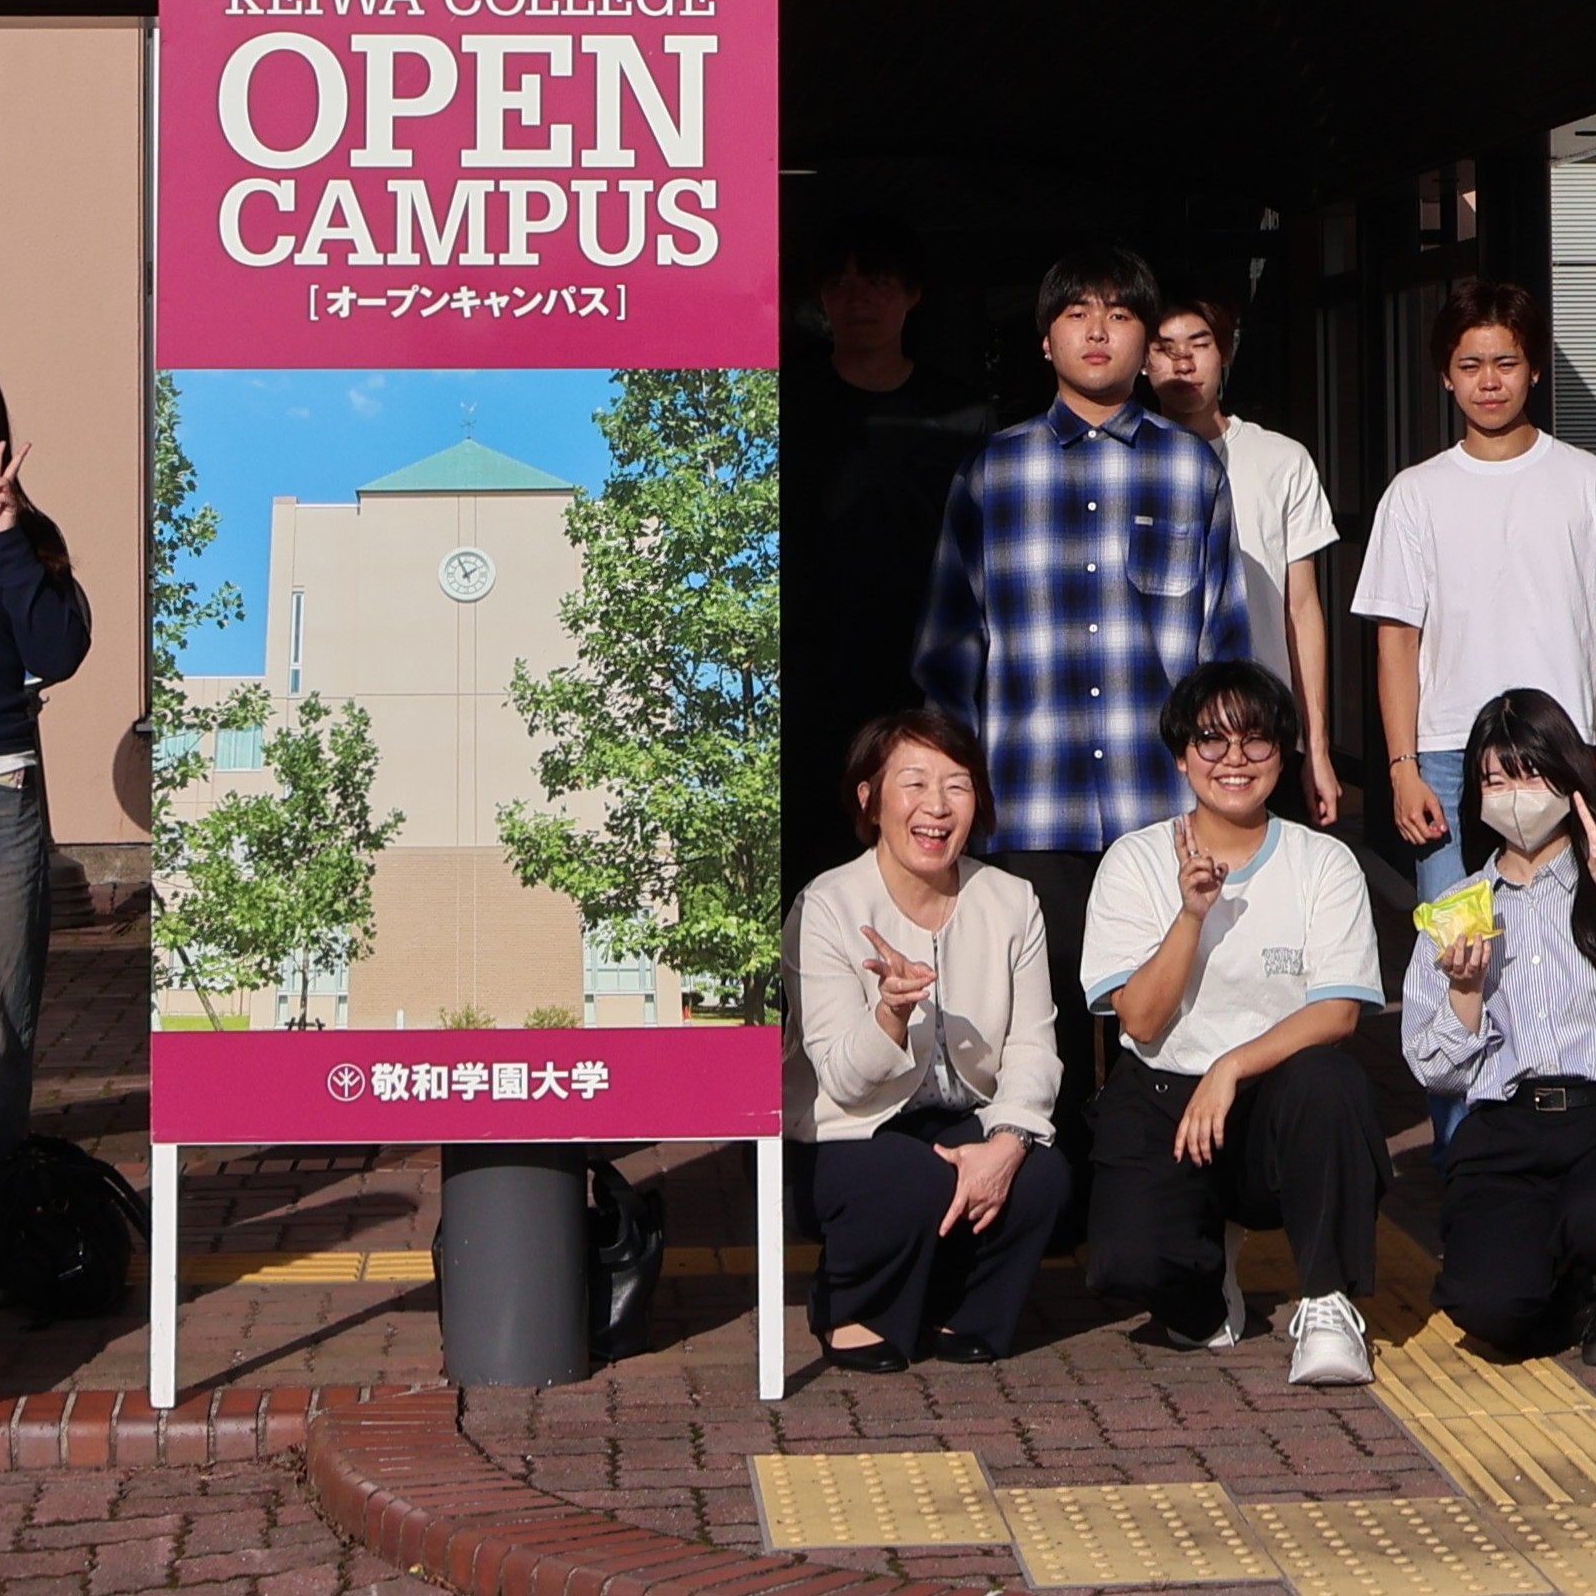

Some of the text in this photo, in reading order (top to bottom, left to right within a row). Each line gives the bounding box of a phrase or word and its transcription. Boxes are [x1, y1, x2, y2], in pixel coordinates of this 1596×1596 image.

[217, 30, 719, 170] OPEN
[217, 177, 720, 268] CAMPUS
[370, 1060, 611, 1101] 敬和学園大学
